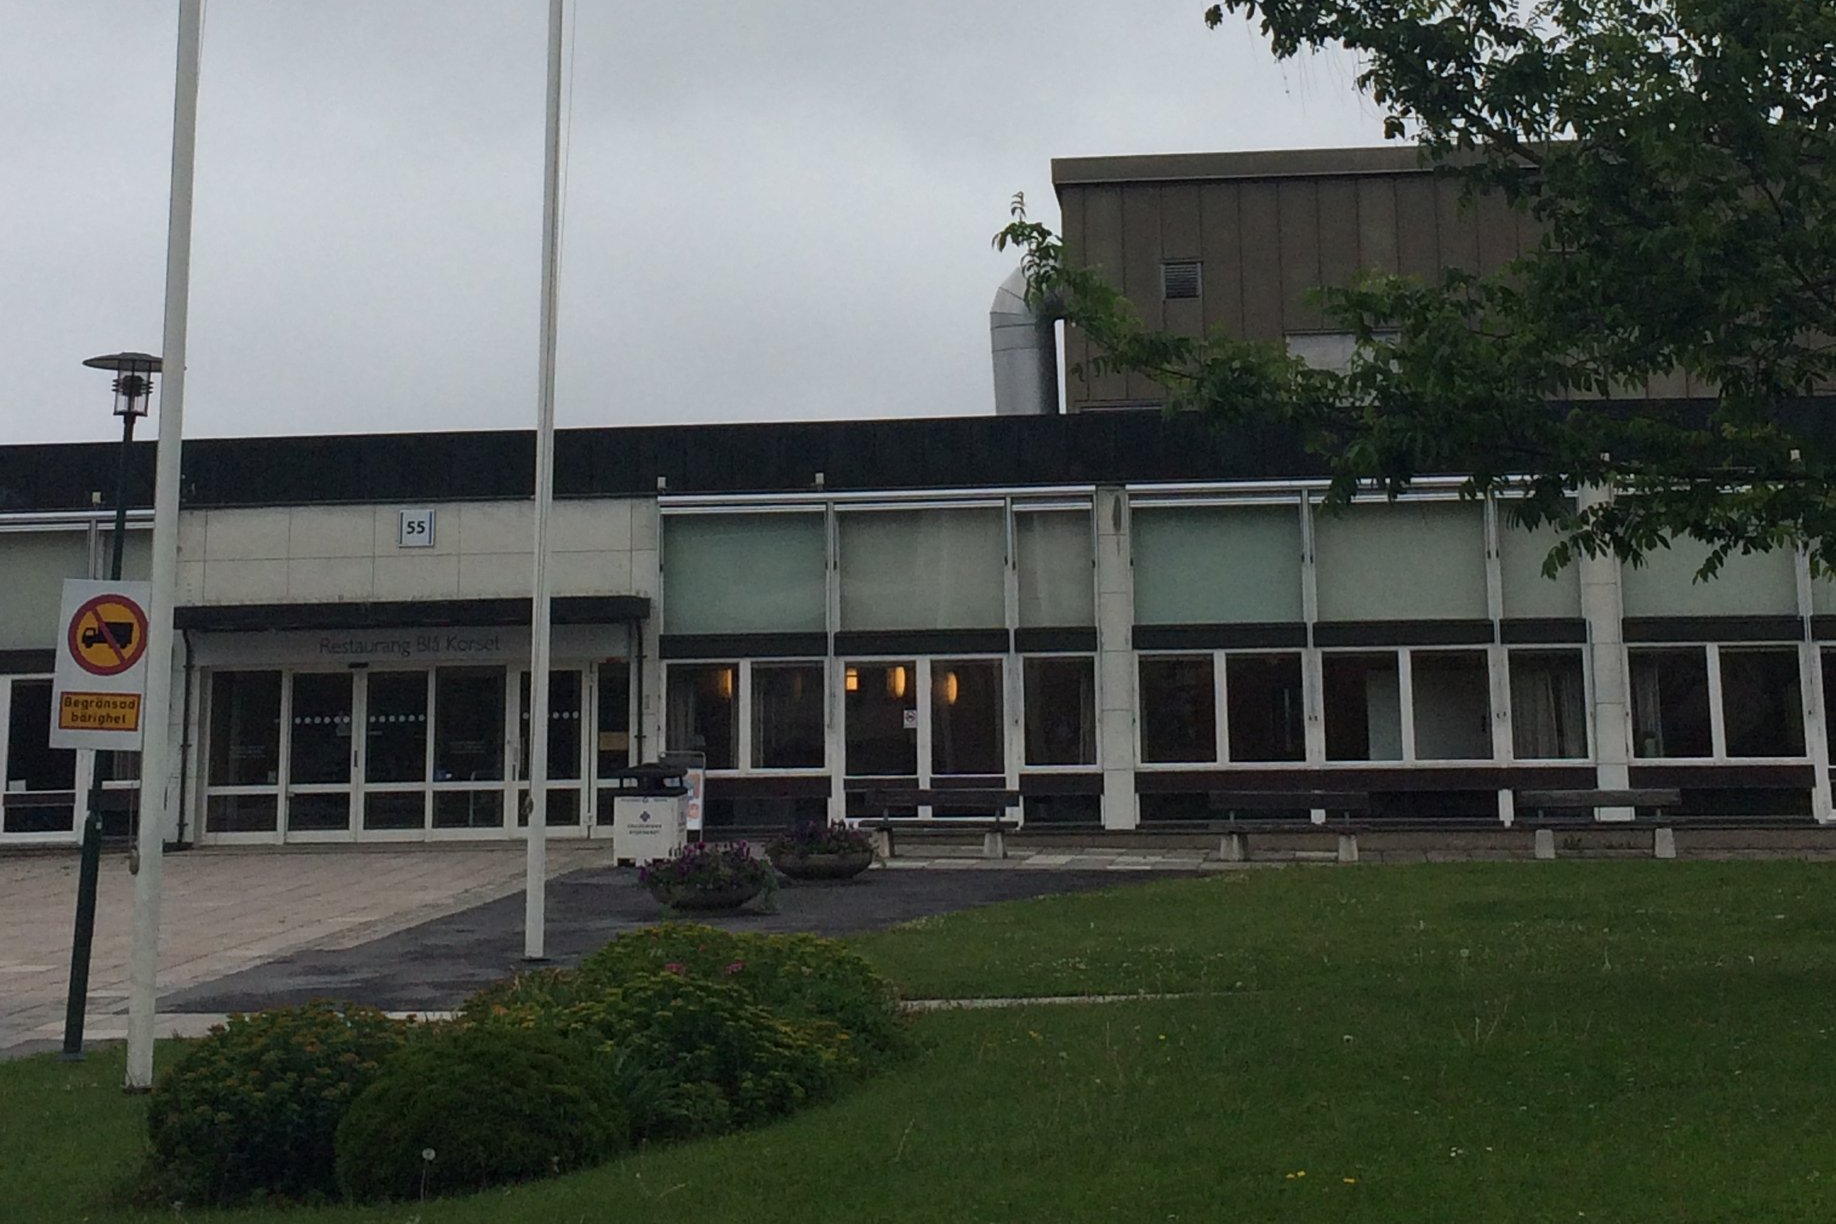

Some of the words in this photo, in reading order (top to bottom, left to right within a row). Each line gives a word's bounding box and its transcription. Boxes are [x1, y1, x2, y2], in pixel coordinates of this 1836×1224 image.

[406, 520, 426, 535] 55
[319, 637, 411, 657] Restaurang
[446, 635, 501, 652] Korset
[64, 696, 136, 710] Begränsad
[71, 711, 126, 725] bärighet
